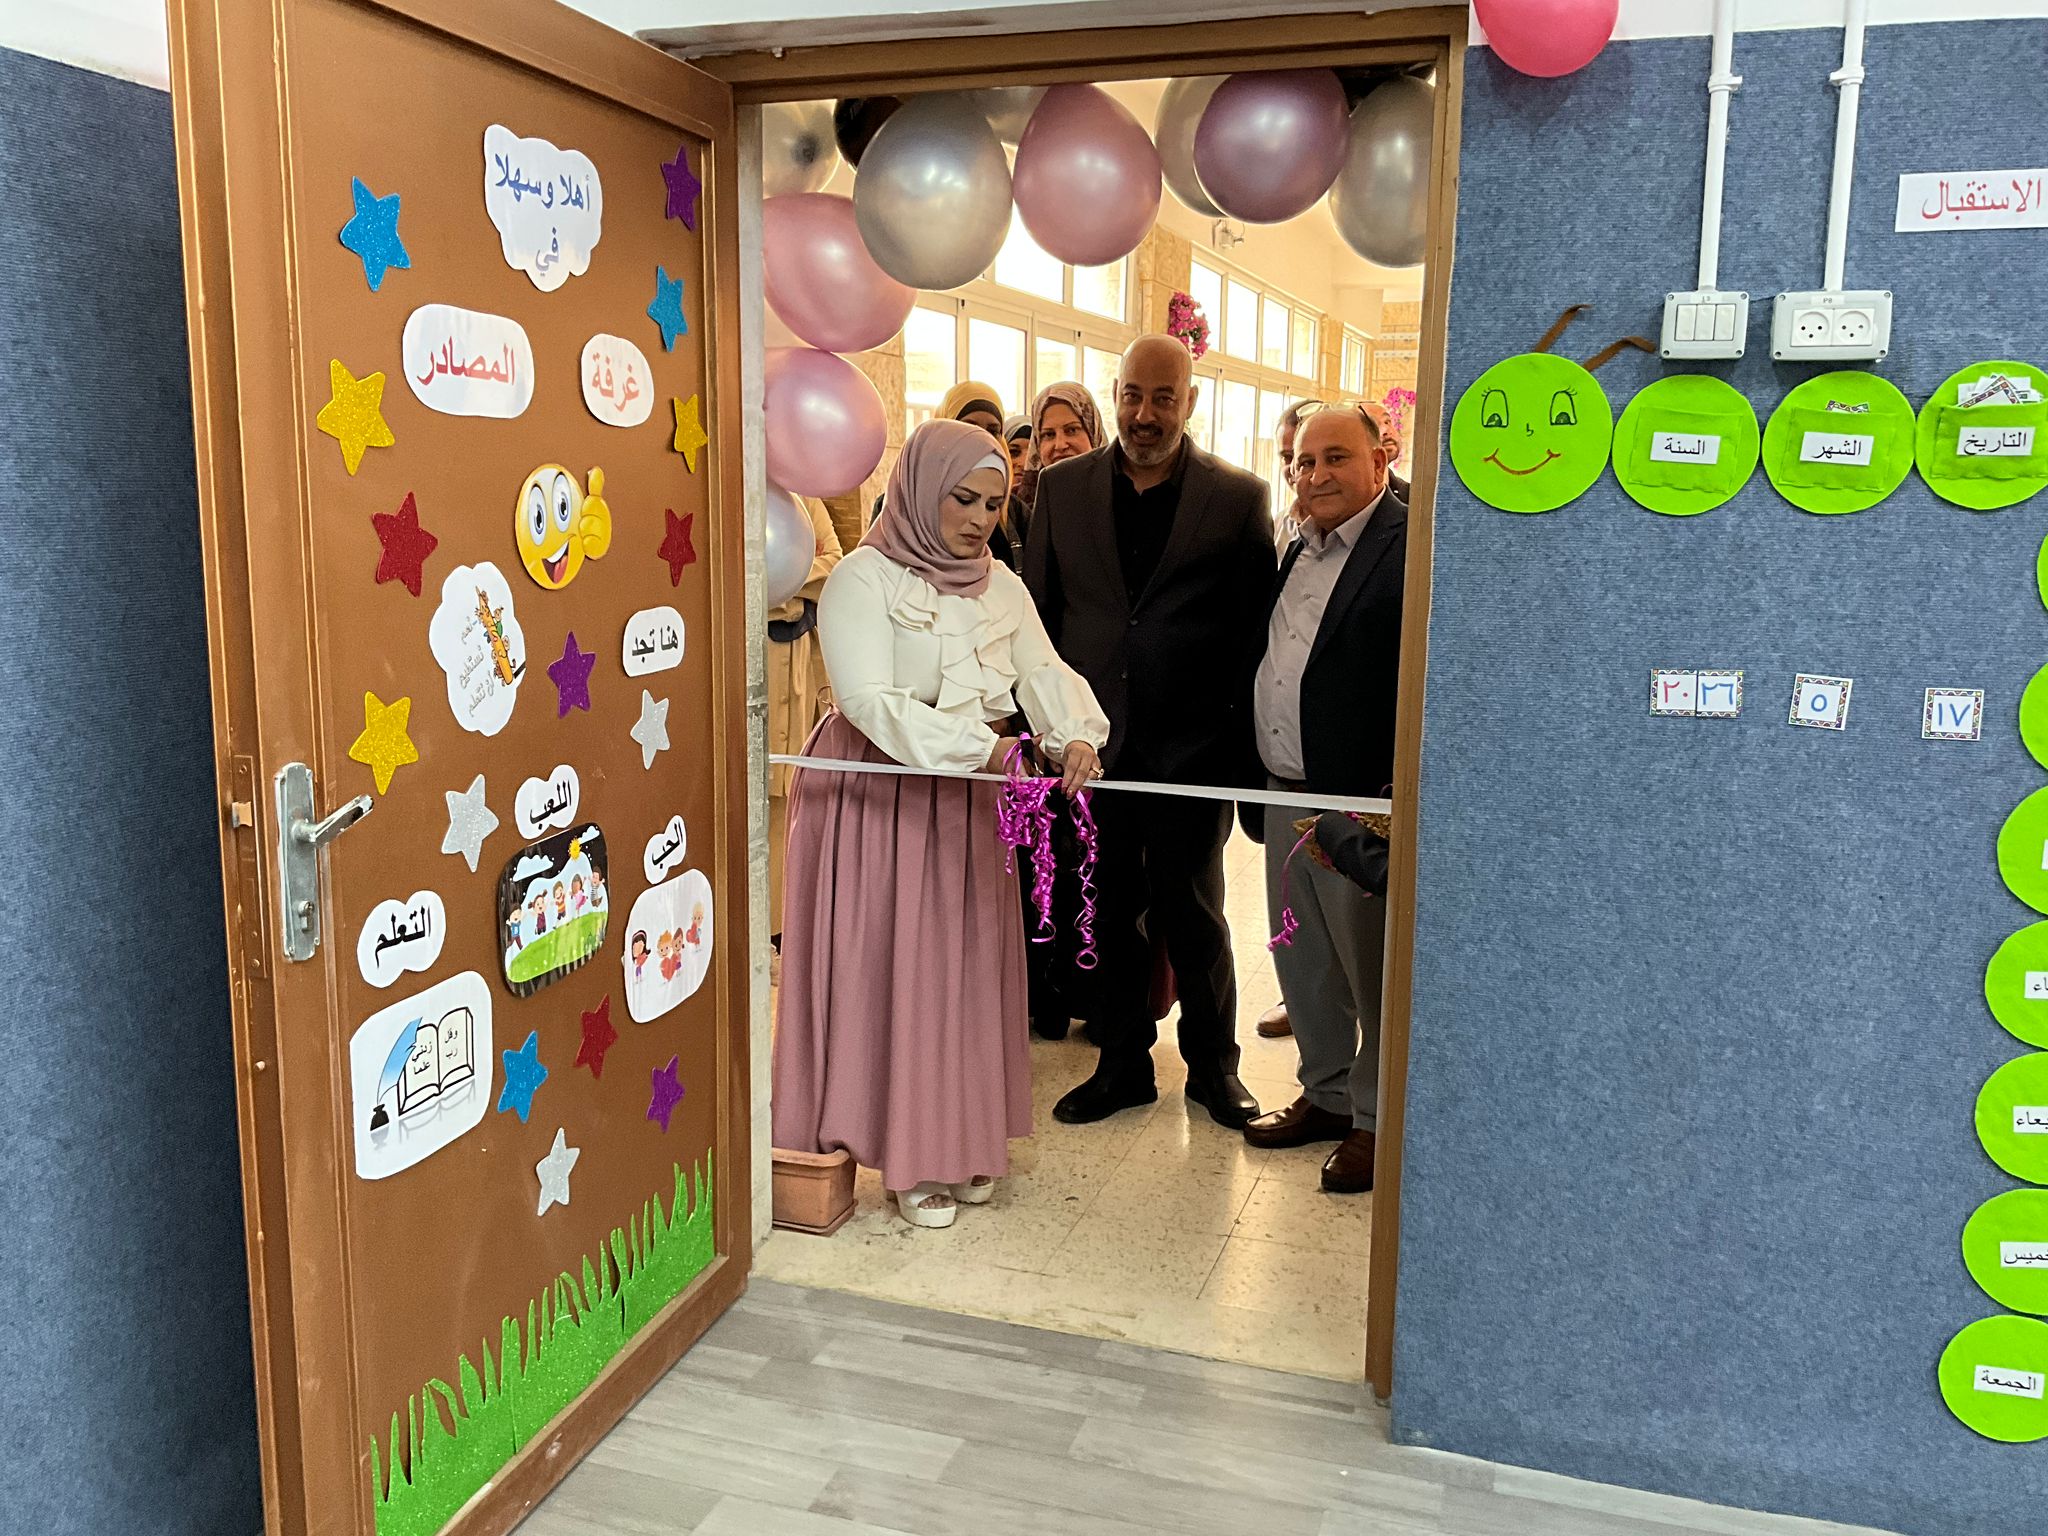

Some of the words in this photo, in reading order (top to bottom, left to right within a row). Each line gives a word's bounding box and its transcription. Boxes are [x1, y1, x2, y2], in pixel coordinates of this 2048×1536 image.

[560, 174, 590, 211] أهلا
[1922, 179, 2041, 220] الاستقبال
[536, 227, 559, 277] في
[417, 337, 515, 386] المصادر
[591, 351, 640, 412] غرفة
[1664, 437, 1705, 455] السنة
[1812, 440, 1861, 459] الشهر
[1964, 432, 2027, 456] التاريخ
[632, 629, 655, 663] تجد
[660, 625, 678, 651] هنا
[1937, 702, 1971, 727] ١٧
[529, 780, 573, 830] اللعب
[651, 822, 683, 869] الحب
[374, 905, 432, 968] التعلم
[1981, 1369, 2036, 1392] الجمعة
